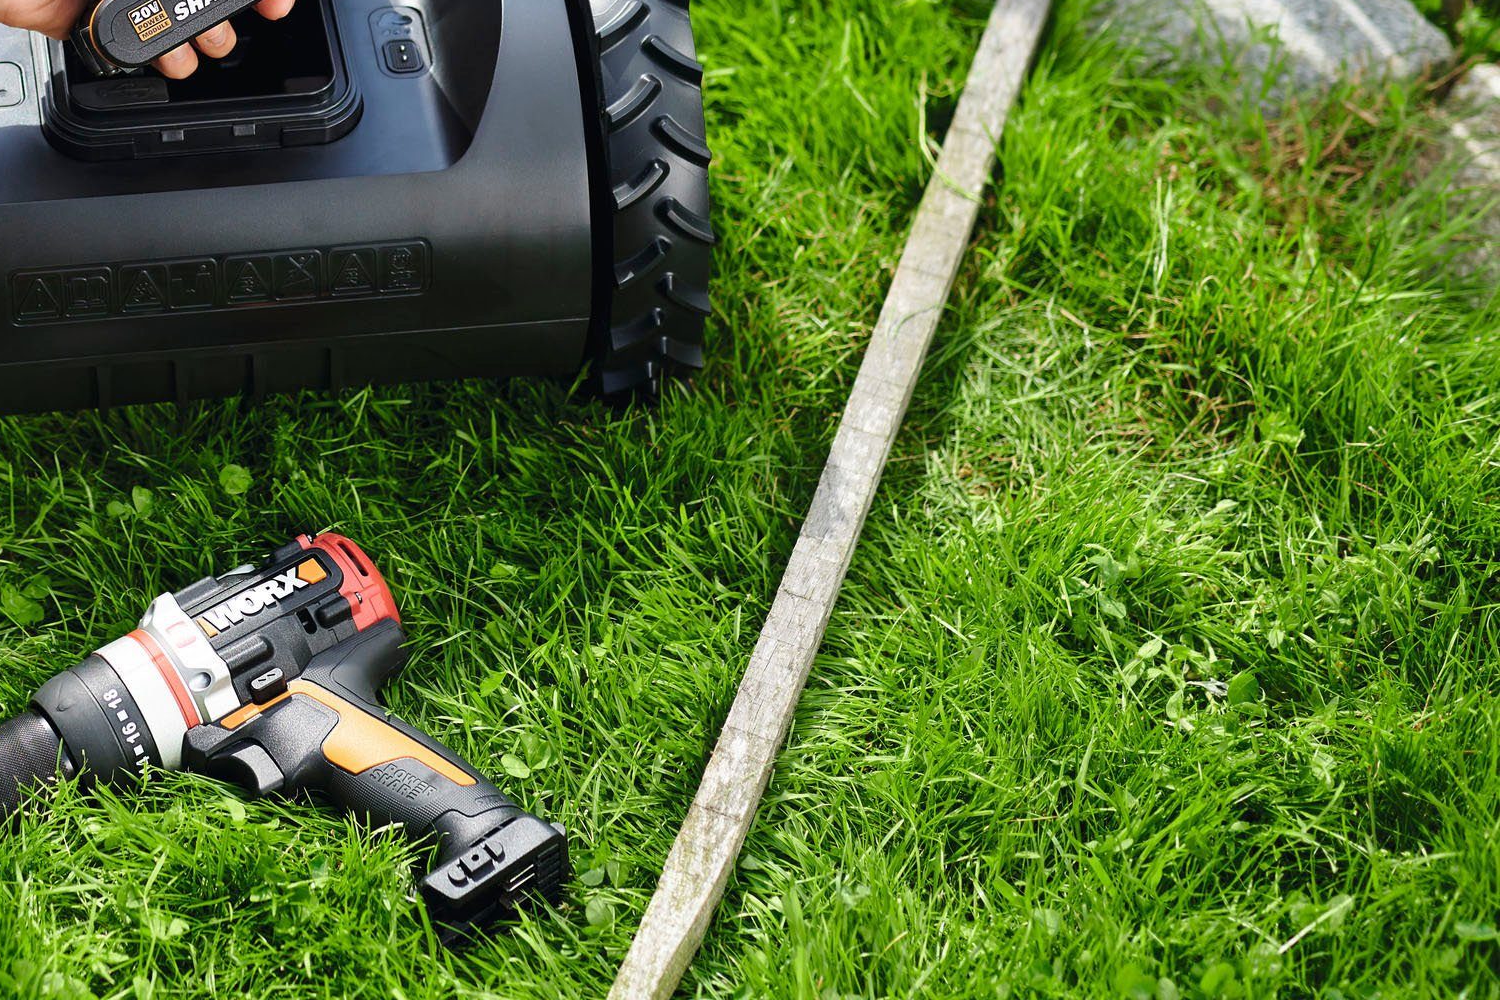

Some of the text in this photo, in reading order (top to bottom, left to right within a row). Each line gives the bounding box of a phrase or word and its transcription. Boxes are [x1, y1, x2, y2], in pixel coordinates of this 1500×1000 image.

[131, 0, 162, 24] 20V
[138, 13, 166, 32] POWER
[141, 21, 170, 39] MODULE
[202, 566, 309, 630] WORX
[103, 688, 123, 711] 18
[121, 721, 141, 744] 16
[383, 763, 438, 797] POWER
